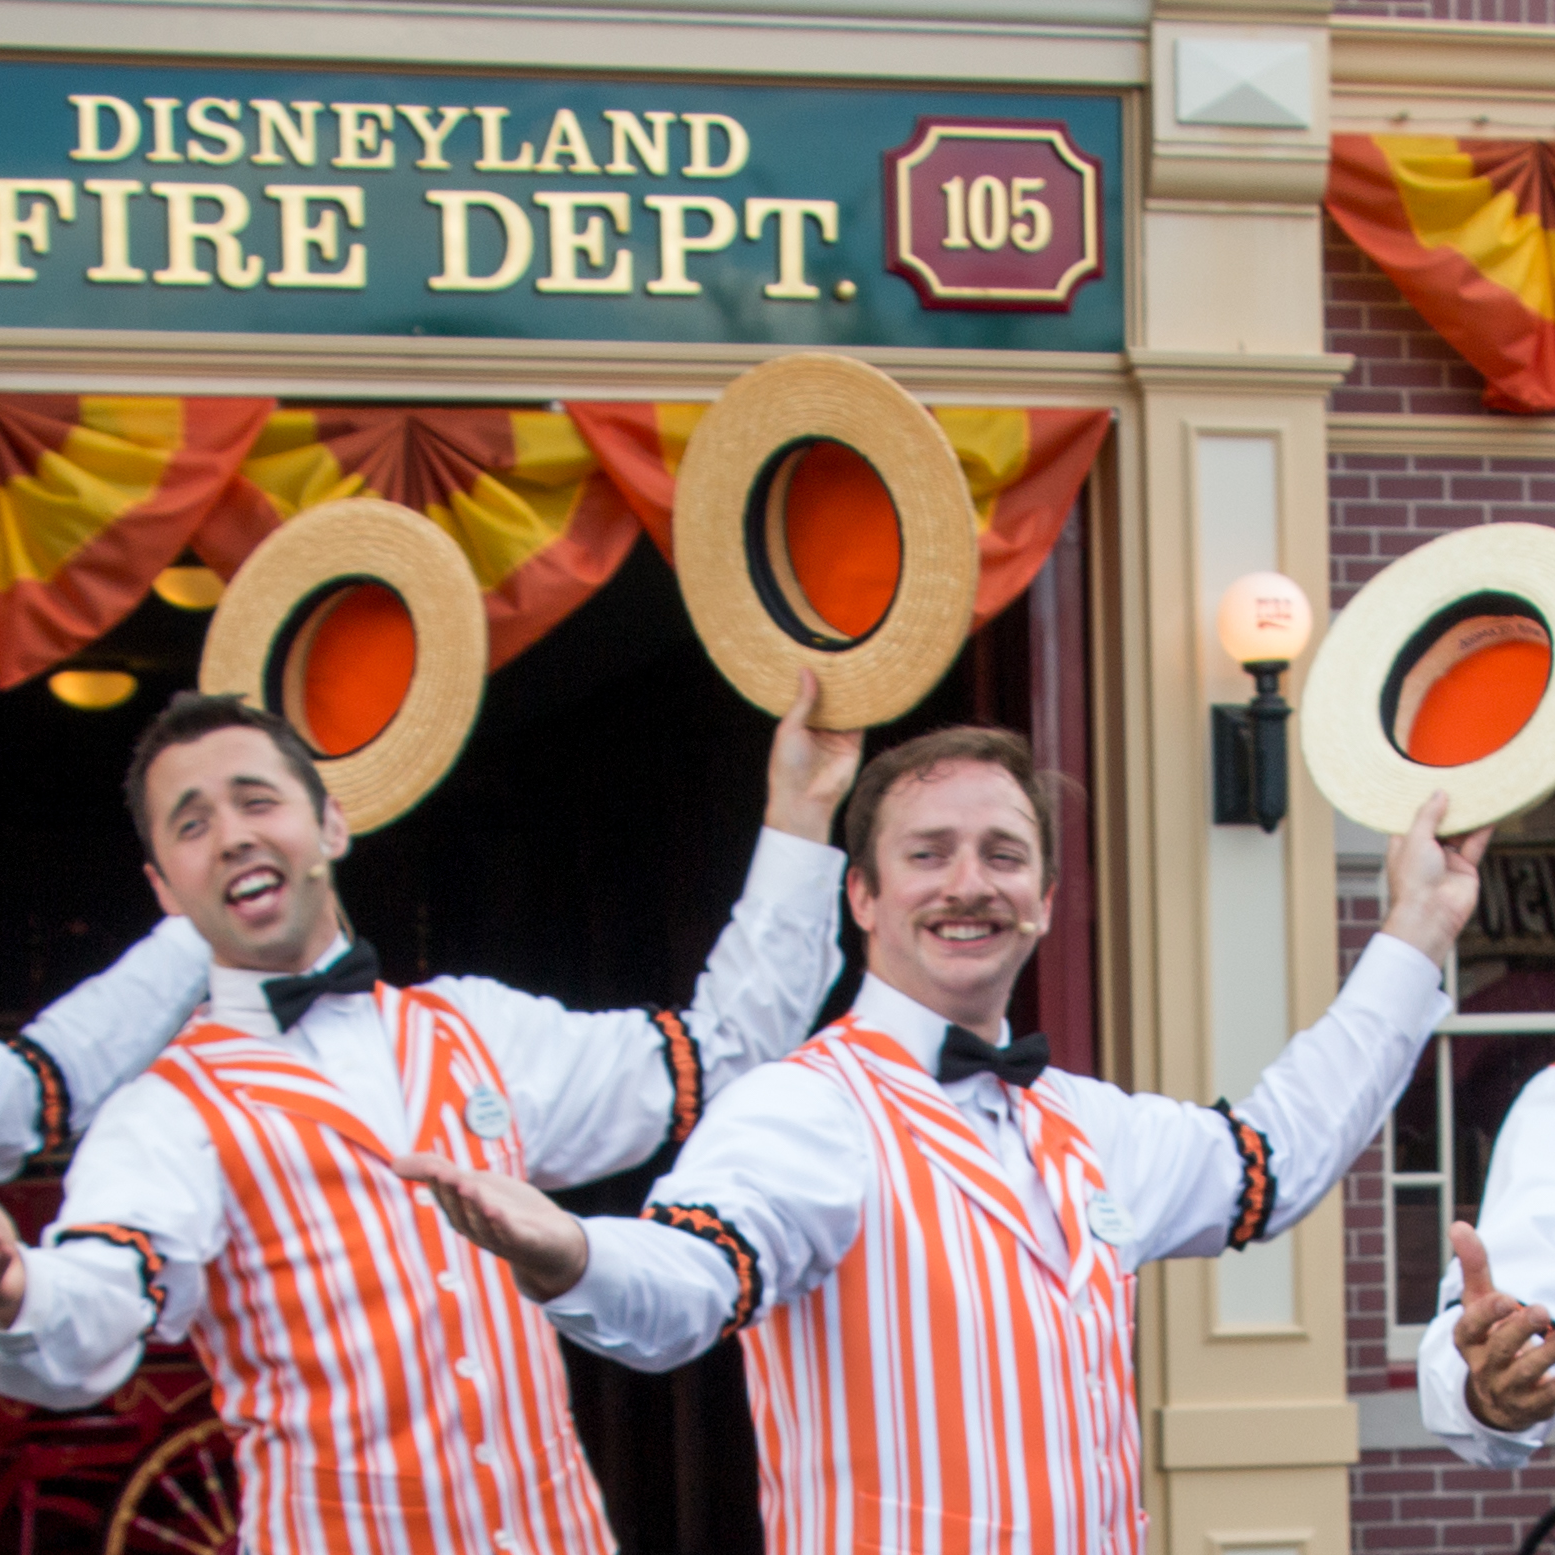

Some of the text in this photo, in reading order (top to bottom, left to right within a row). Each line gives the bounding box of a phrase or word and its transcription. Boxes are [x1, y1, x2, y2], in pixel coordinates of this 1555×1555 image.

[67, 93, 751, 179] DISNEYLAND
[425, 189, 857, 300] DEPT.
[941, 174, 1053, 253] 105
